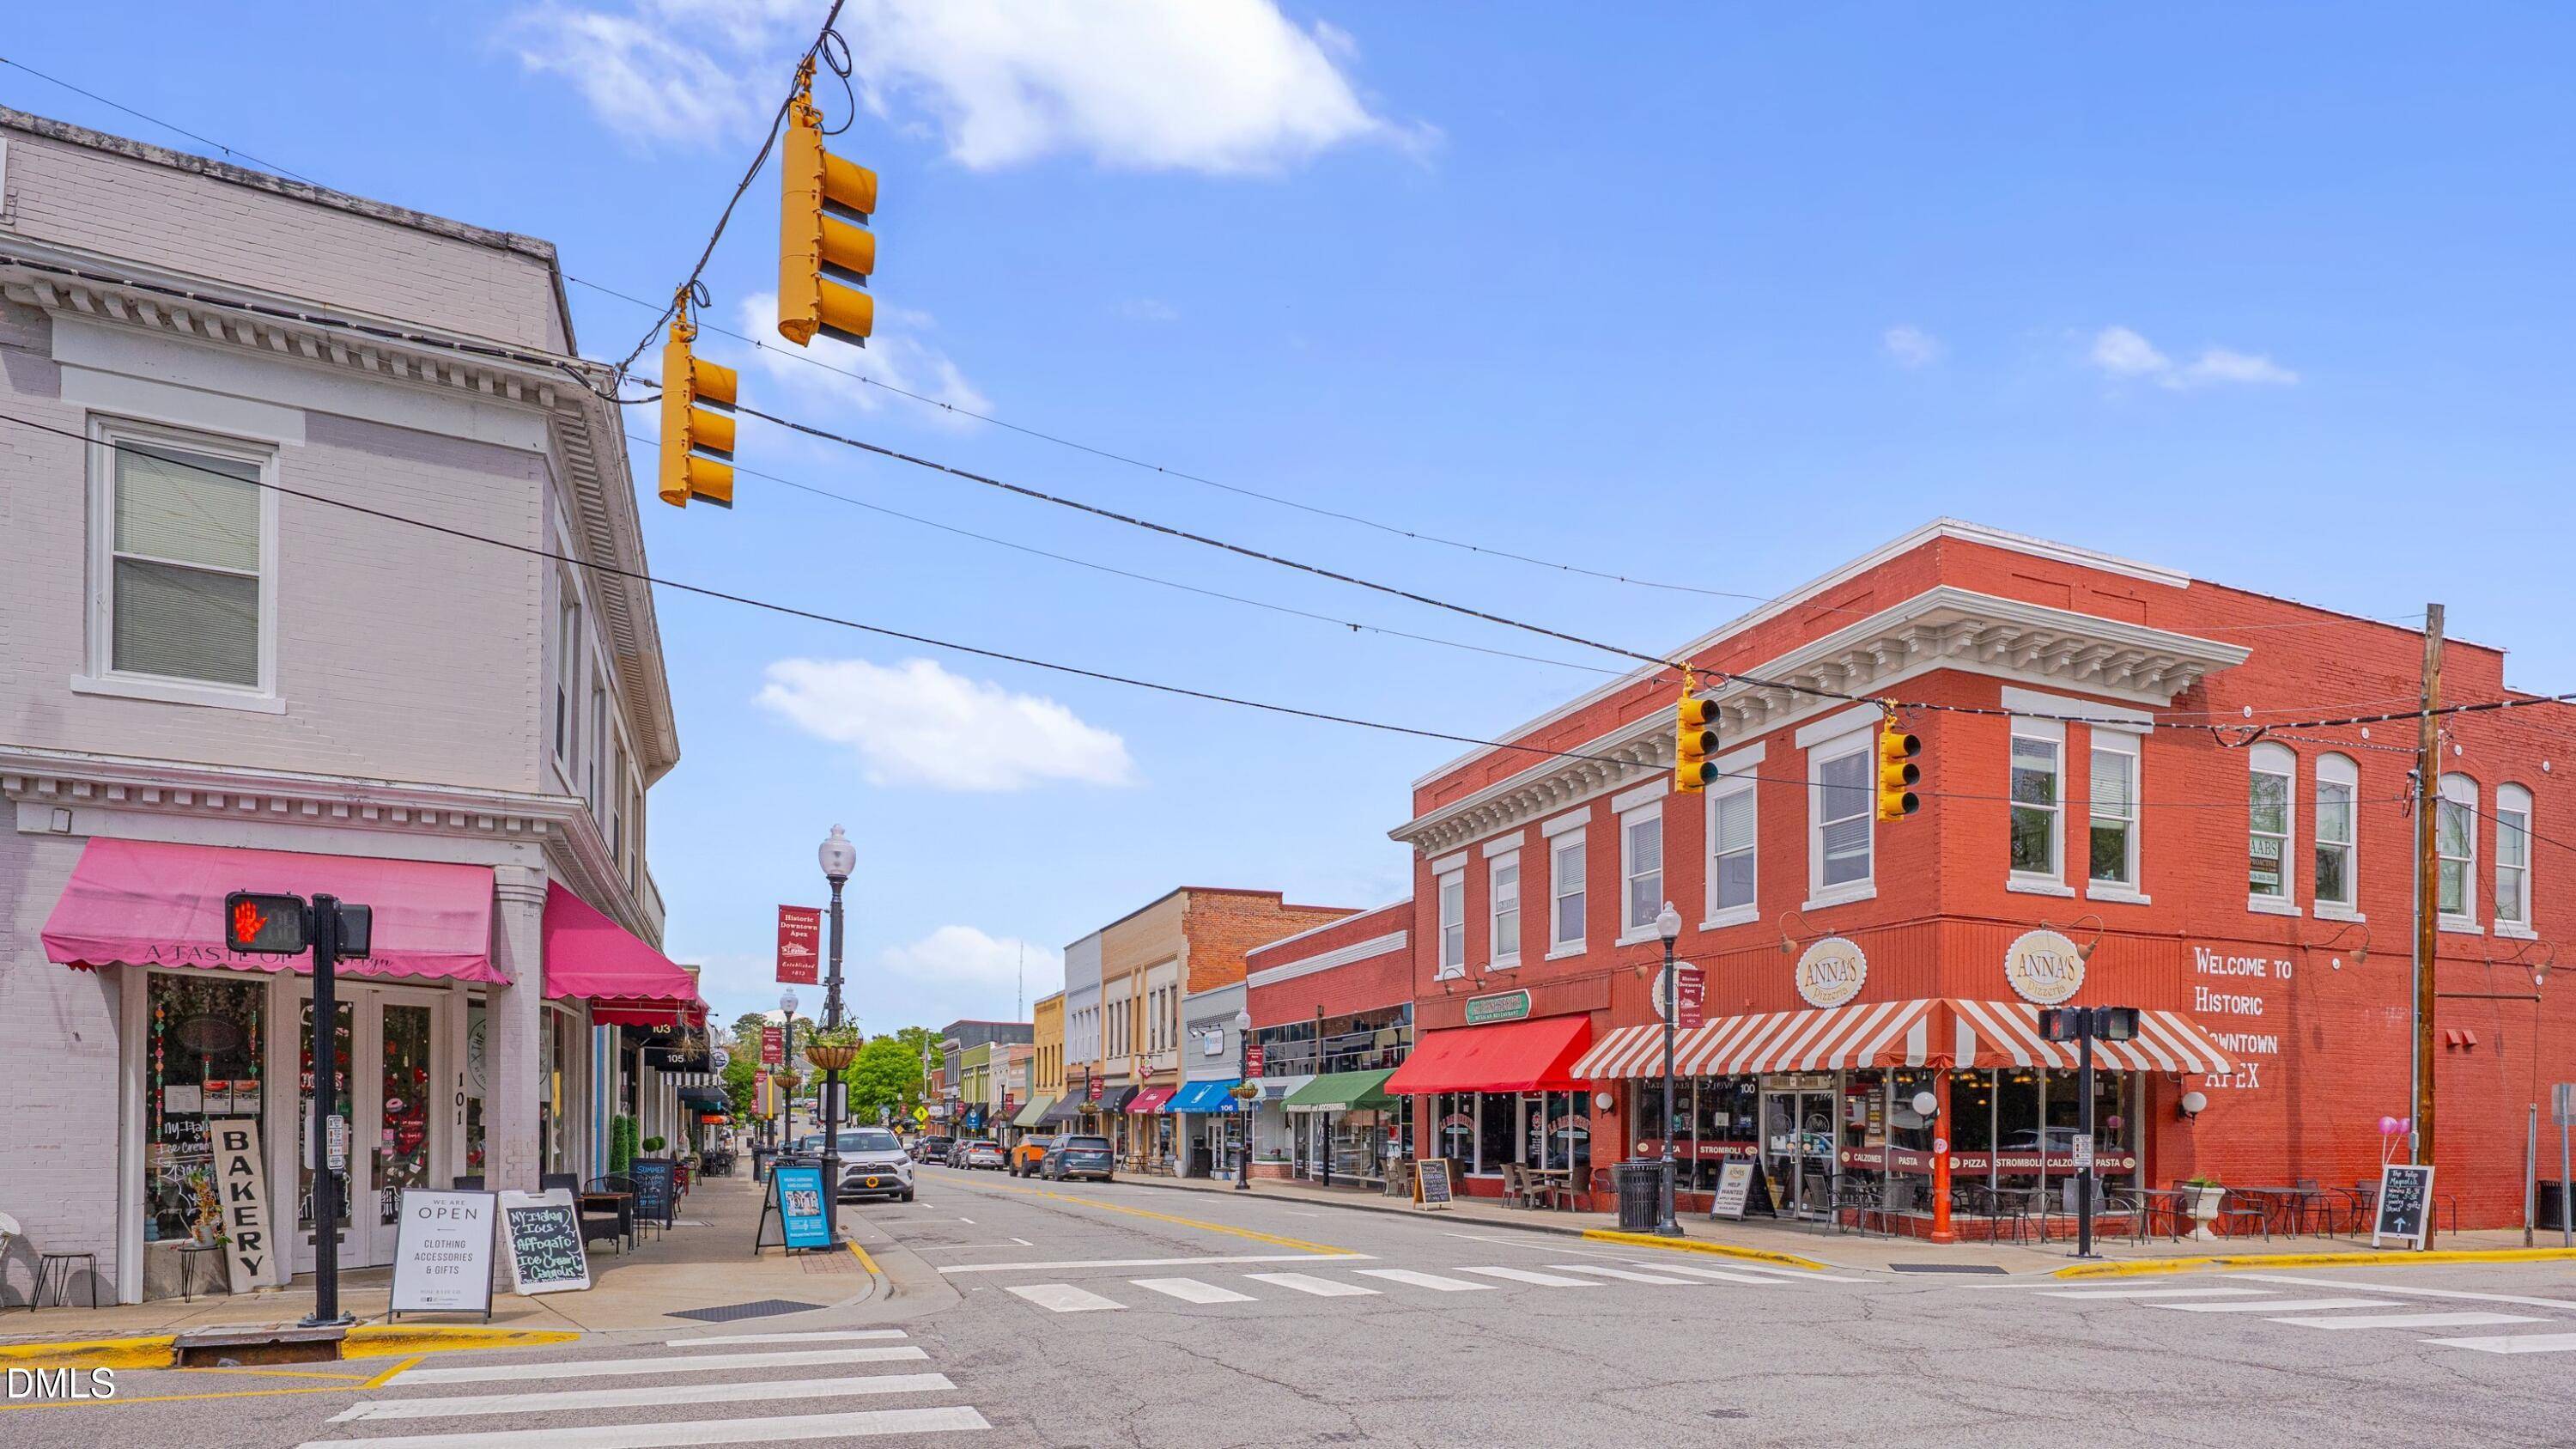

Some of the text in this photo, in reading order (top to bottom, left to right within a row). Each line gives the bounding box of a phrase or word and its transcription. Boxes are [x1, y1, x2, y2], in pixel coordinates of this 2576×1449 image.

[785, 914, 814, 922] Historic
[781, 922, 817, 930] Downtown
[790, 929, 808, 938] Apex
[145, 946, 161, 959] A
[1805, 957, 1856, 987] ANNA'S
[2016, 953, 2075, 981] ANNA'S
[667, 1054, 684, 1062] 105
[1740, 1083, 1755, 1093] 100
[455, 1072, 464, 1125] 101
[1700, 1146, 1741, 1154] STROMBOLI
[1853, 1154, 1918, 1166] CALZONES PASTA
[1963, 1159, 2120, 1168] PIZZA STROMBOLI CALZO PASTA
[222, 1130, 264, 1277] BAKERY
[418, 1207, 477, 1220] OPEN
[424, 1239, 465, 1249] CLOTHING
[414, 1252, 473, 1262] ACCESSORIES
[426, 1265, 459, 1275] & GIFTS
